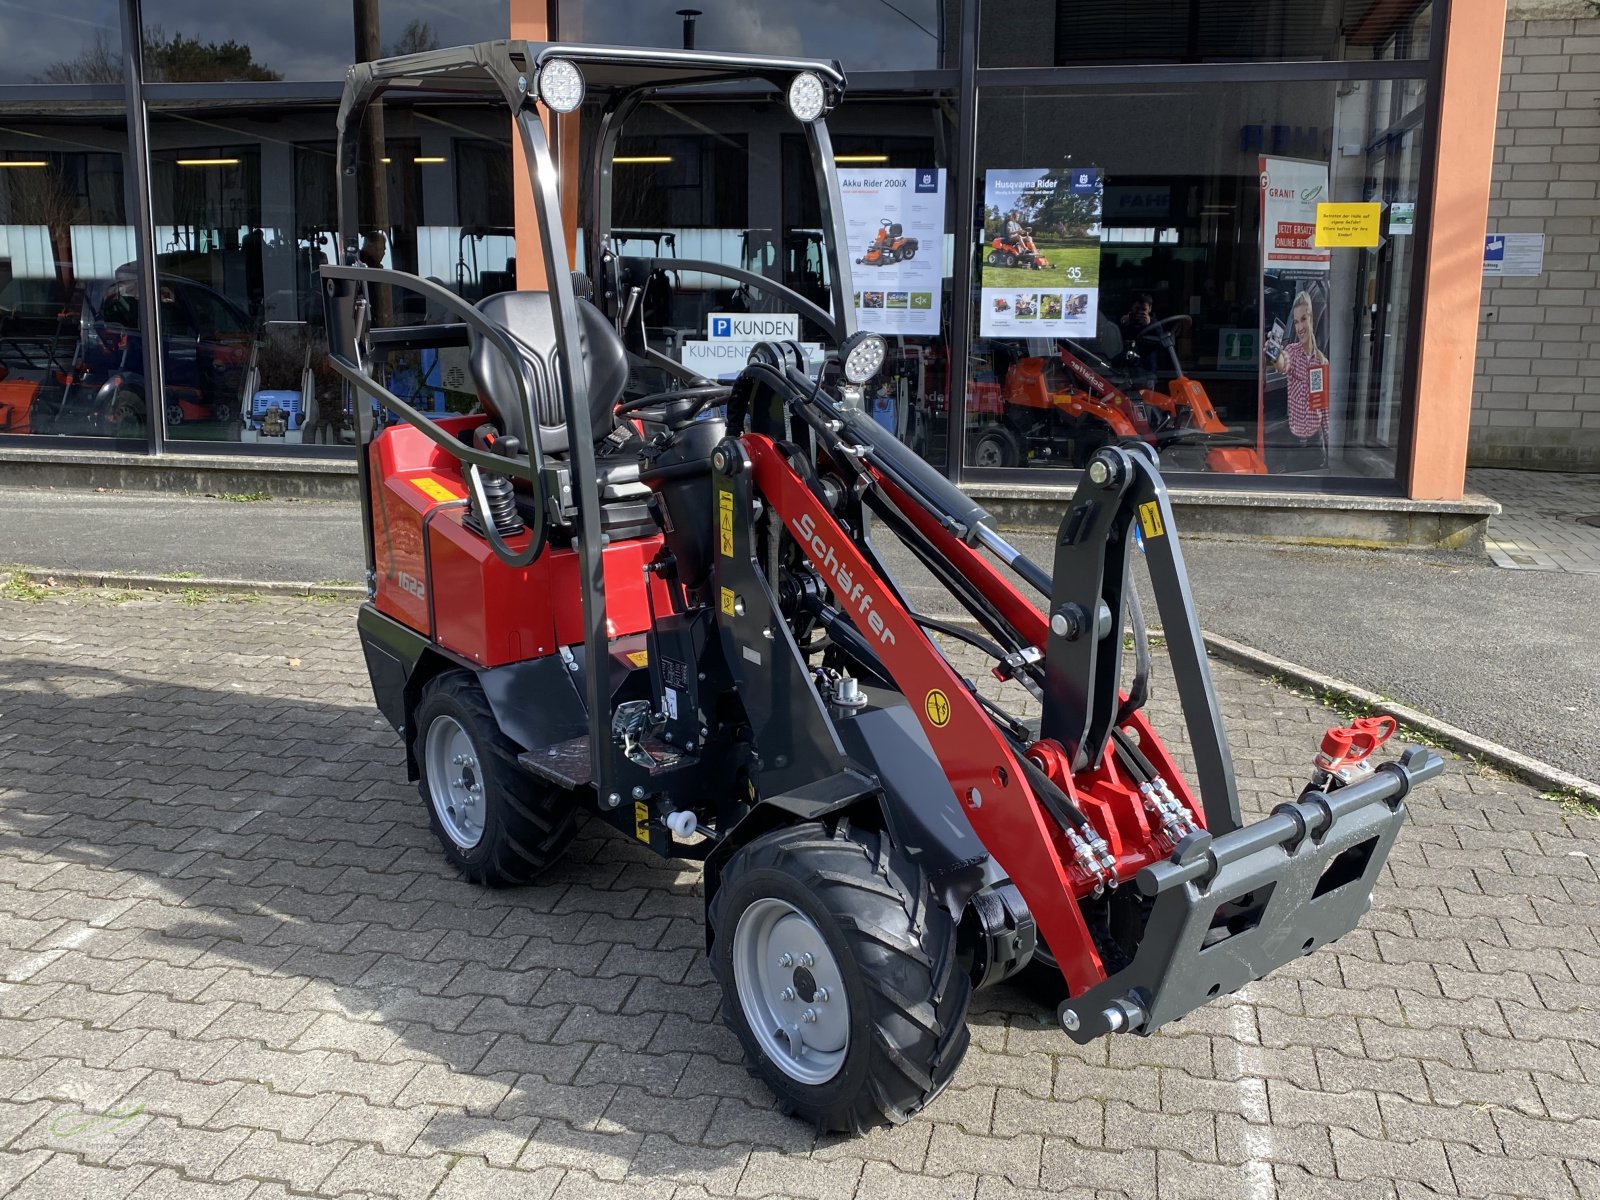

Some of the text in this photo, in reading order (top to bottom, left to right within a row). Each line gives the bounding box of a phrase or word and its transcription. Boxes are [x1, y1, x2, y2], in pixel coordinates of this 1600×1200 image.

[842, 179, 907, 188] Akku Rider 200iX
[994, 179, 1058, 190] Husqvarna Rider
[1269, 188, 1295, 199] GRANIT
[1278, 224, 1315, 235] JETZT ERSATZT
[1276, 237, 1295, 247] ONLINE
[1066, 266, 1081, 279] 35
[717, 319, 794, 337] P KUNDEN
[398, 570, 425, 600] 1622
[792, 513, 896, 647] Schäffer
